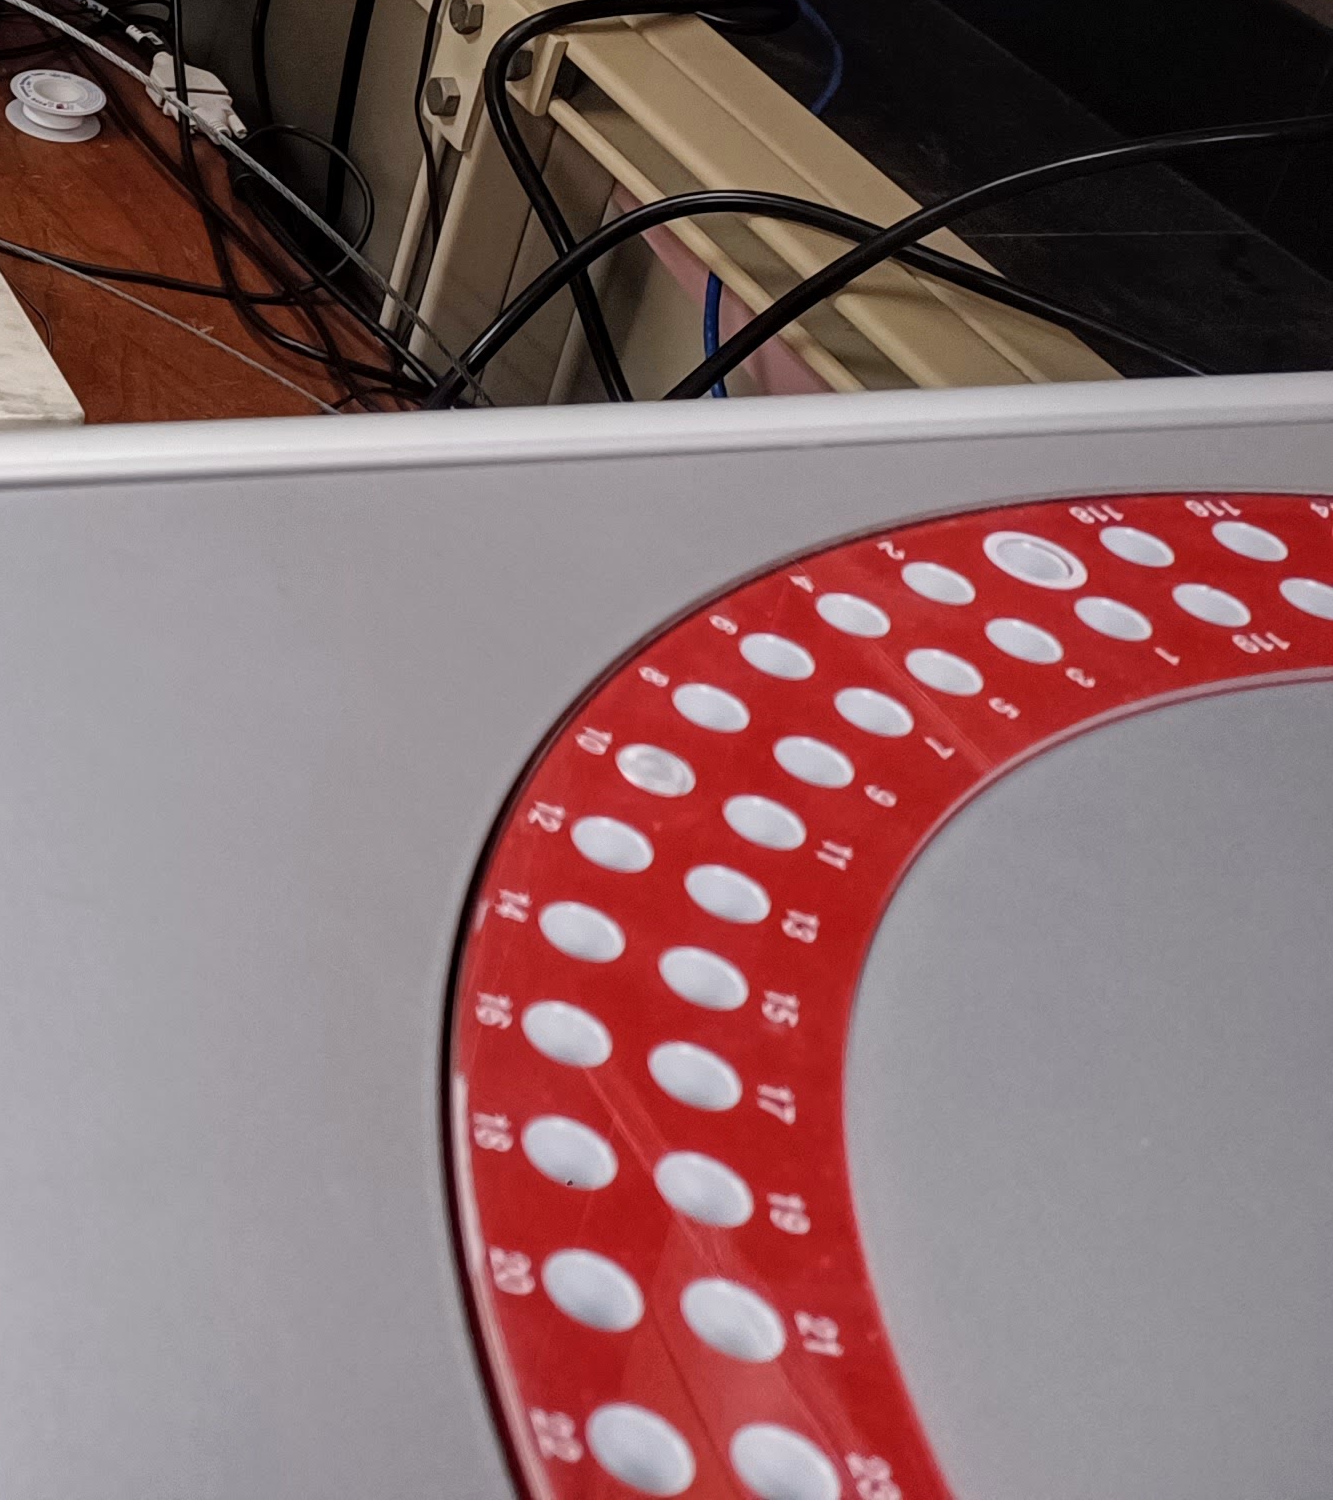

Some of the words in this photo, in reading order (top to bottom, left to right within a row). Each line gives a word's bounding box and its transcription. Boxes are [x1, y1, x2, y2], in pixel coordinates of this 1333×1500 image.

[1068, 503, 1125, 524] 118
[876, 539, 906, 561] 2
[789, 574, 816, 594] 4
[709, 614, 739, 636] 6
[1154, 646, 1181, 667] 1
[1231, 631, 1291, 654] 119
[638, 666, 670, 688] 8
[1065, 666, 1096, 689] 3
[988, 697, 1021, 720] 5
[575, 726, 613, 756] 10
[924, 736, 956, 761] 7
[864, 785, 898, 808] 9
[528, 801, 567, 833] 12
[816, 840, 854, 871] 11
[495, 888, 532, 923] 14
[781, 909, 821, 944] 13
[475, 991, 514, 1029] 16
[762, 990, 801, 1028] 15
[757, 1083, 797, 1125] 17
[473, 1112, 514, 1153] 18
[767, 1193, 811, 1235] 19
[489, 1247, 536, 1296] 20
[794, 1311, 845, 1357] 21
[529, 1407, 584, 1463] 22
[844, 1452, 903, 1500] 23
